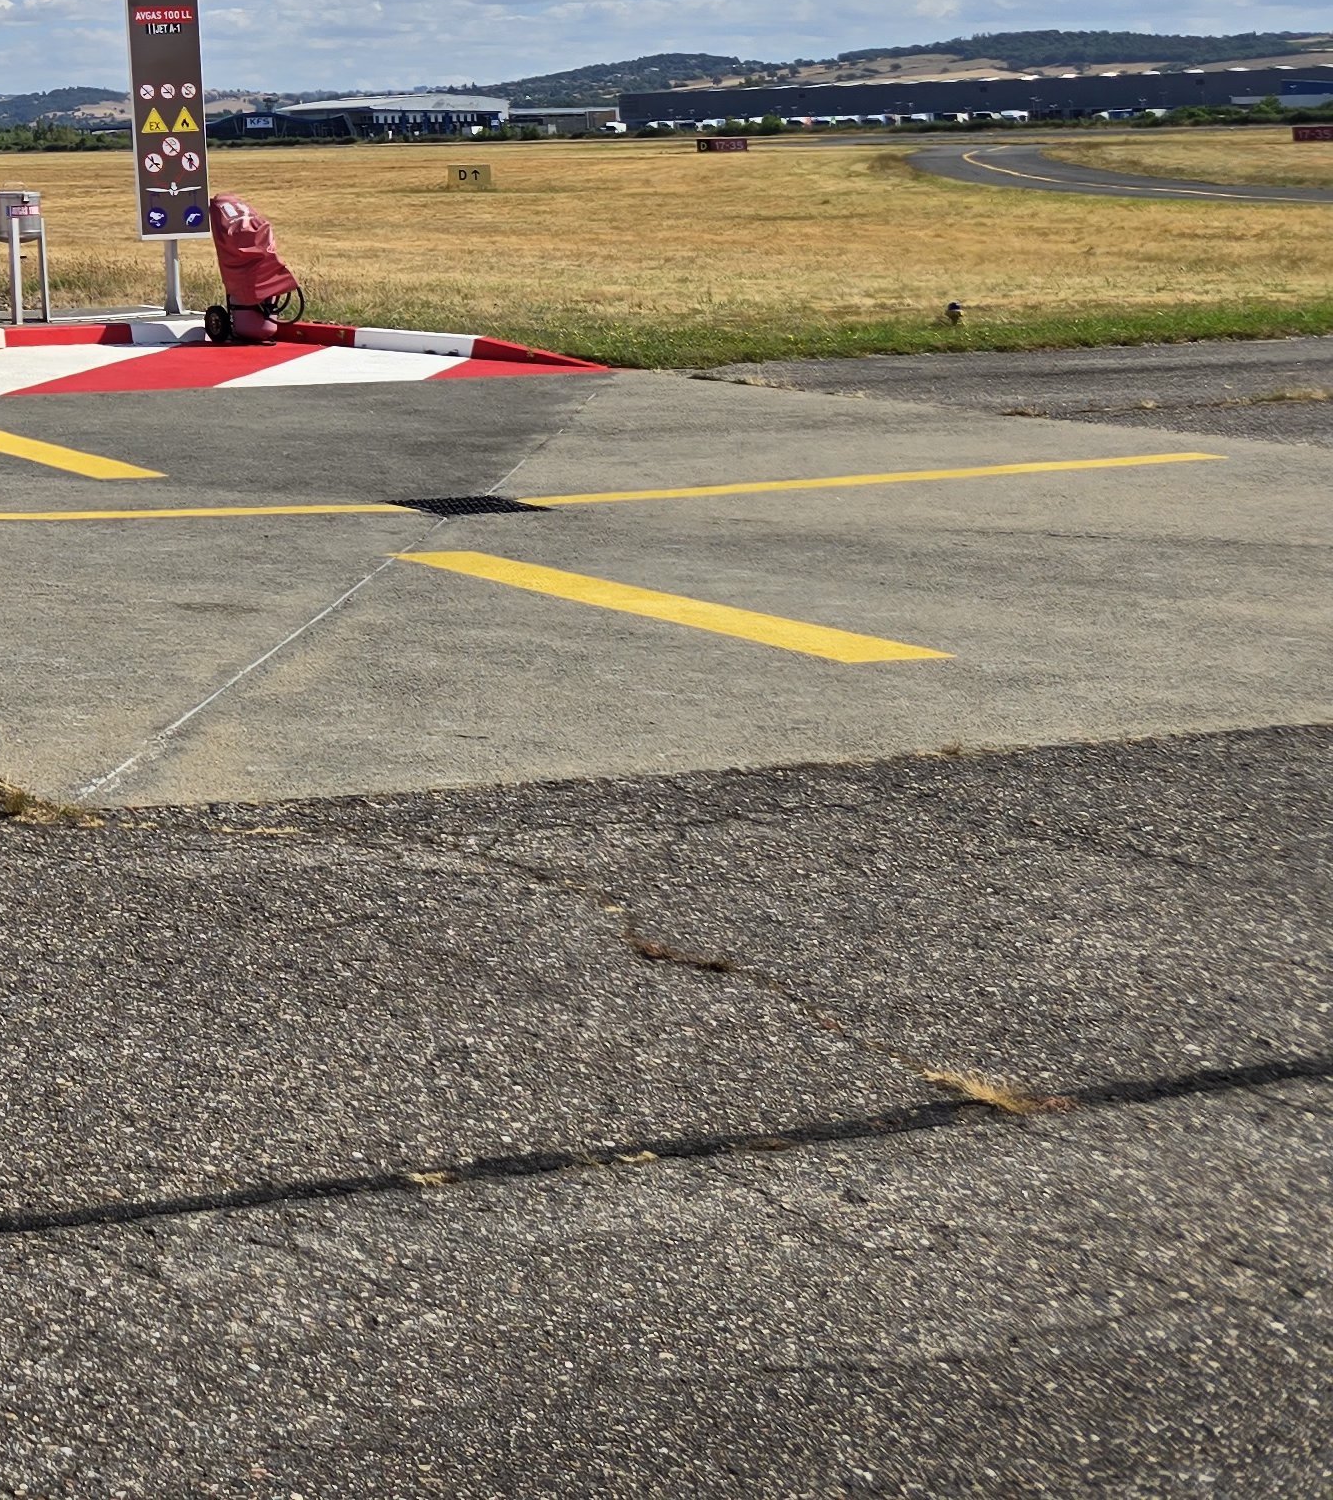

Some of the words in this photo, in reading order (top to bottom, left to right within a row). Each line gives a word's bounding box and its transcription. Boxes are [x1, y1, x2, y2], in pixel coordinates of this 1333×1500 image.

[135, 11, 162, 20] AVGAS
[164, 10, 180, 20] 100
[181, 10, 193, 19] LL
[155, 23, 168, 34] JET
[169, 23, 181, 33] A-1
[249, 117, 270, 125] KFS
[700, 141, 708, 151] D
[715, 141, 744, 150] 17-35
[458, 169, 467, 180] D
